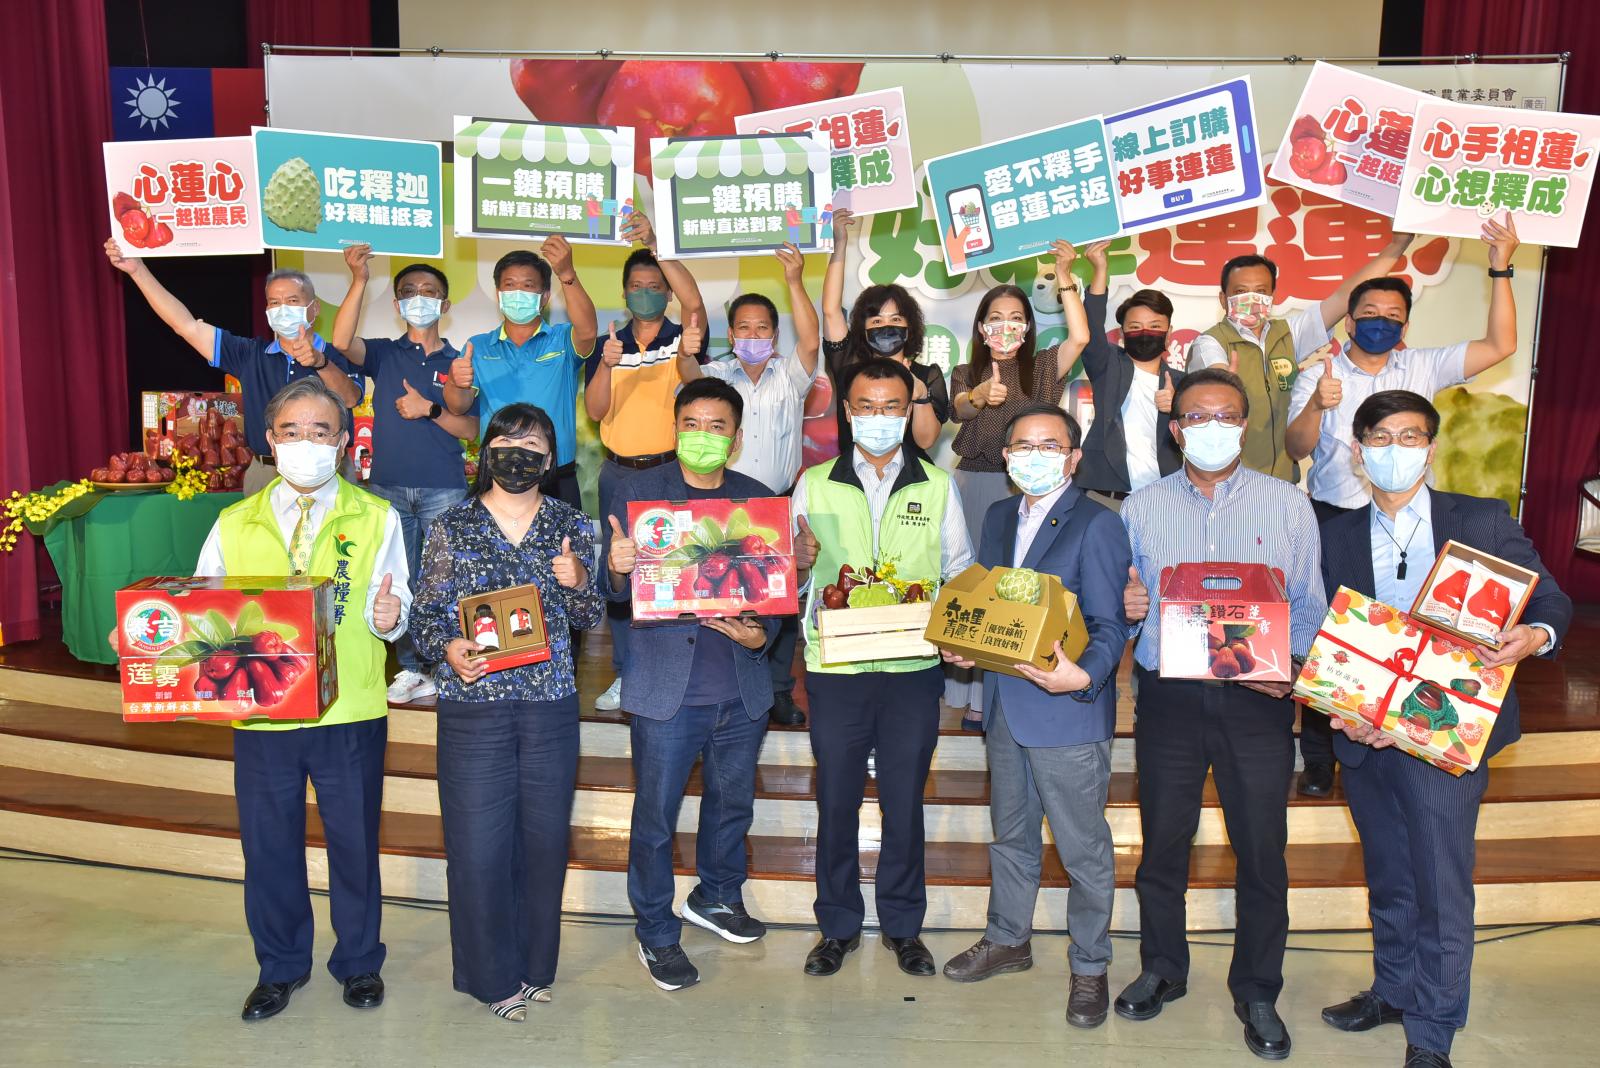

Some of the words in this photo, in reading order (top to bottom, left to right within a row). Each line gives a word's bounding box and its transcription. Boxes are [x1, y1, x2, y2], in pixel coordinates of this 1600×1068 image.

[1112, 106, 1230, 163] 線上訂購
[1422, 121, 1578, 170] 心手相蓮
[134, 162, 244, 204] 心蓮心
[324, 167, 429, 205] 吃釋迦
[482, 168, 604, 201] 一鍵預購
[984, 142, 1104, 197] 愛不釋手
[1118, 143, 1236, 198] 好事連蓮
[682, 181, 803, 214] 一鍵預購
[990, 175, 1111, 230] 留蓮忘返
[1170, 194, 1185, 203] BUY
[1414, 166, 1567, 214] 心想釋成
[156, 205, 248, 227] 一起挺農民
[325, 202, 433, 228] 好釋攏抵家
[481, 199, 583, 220] 新鮮直送到家
[682, 216, 783, 236] 新鮮直送到家
[127, 662, 180, 687] 莲雾
